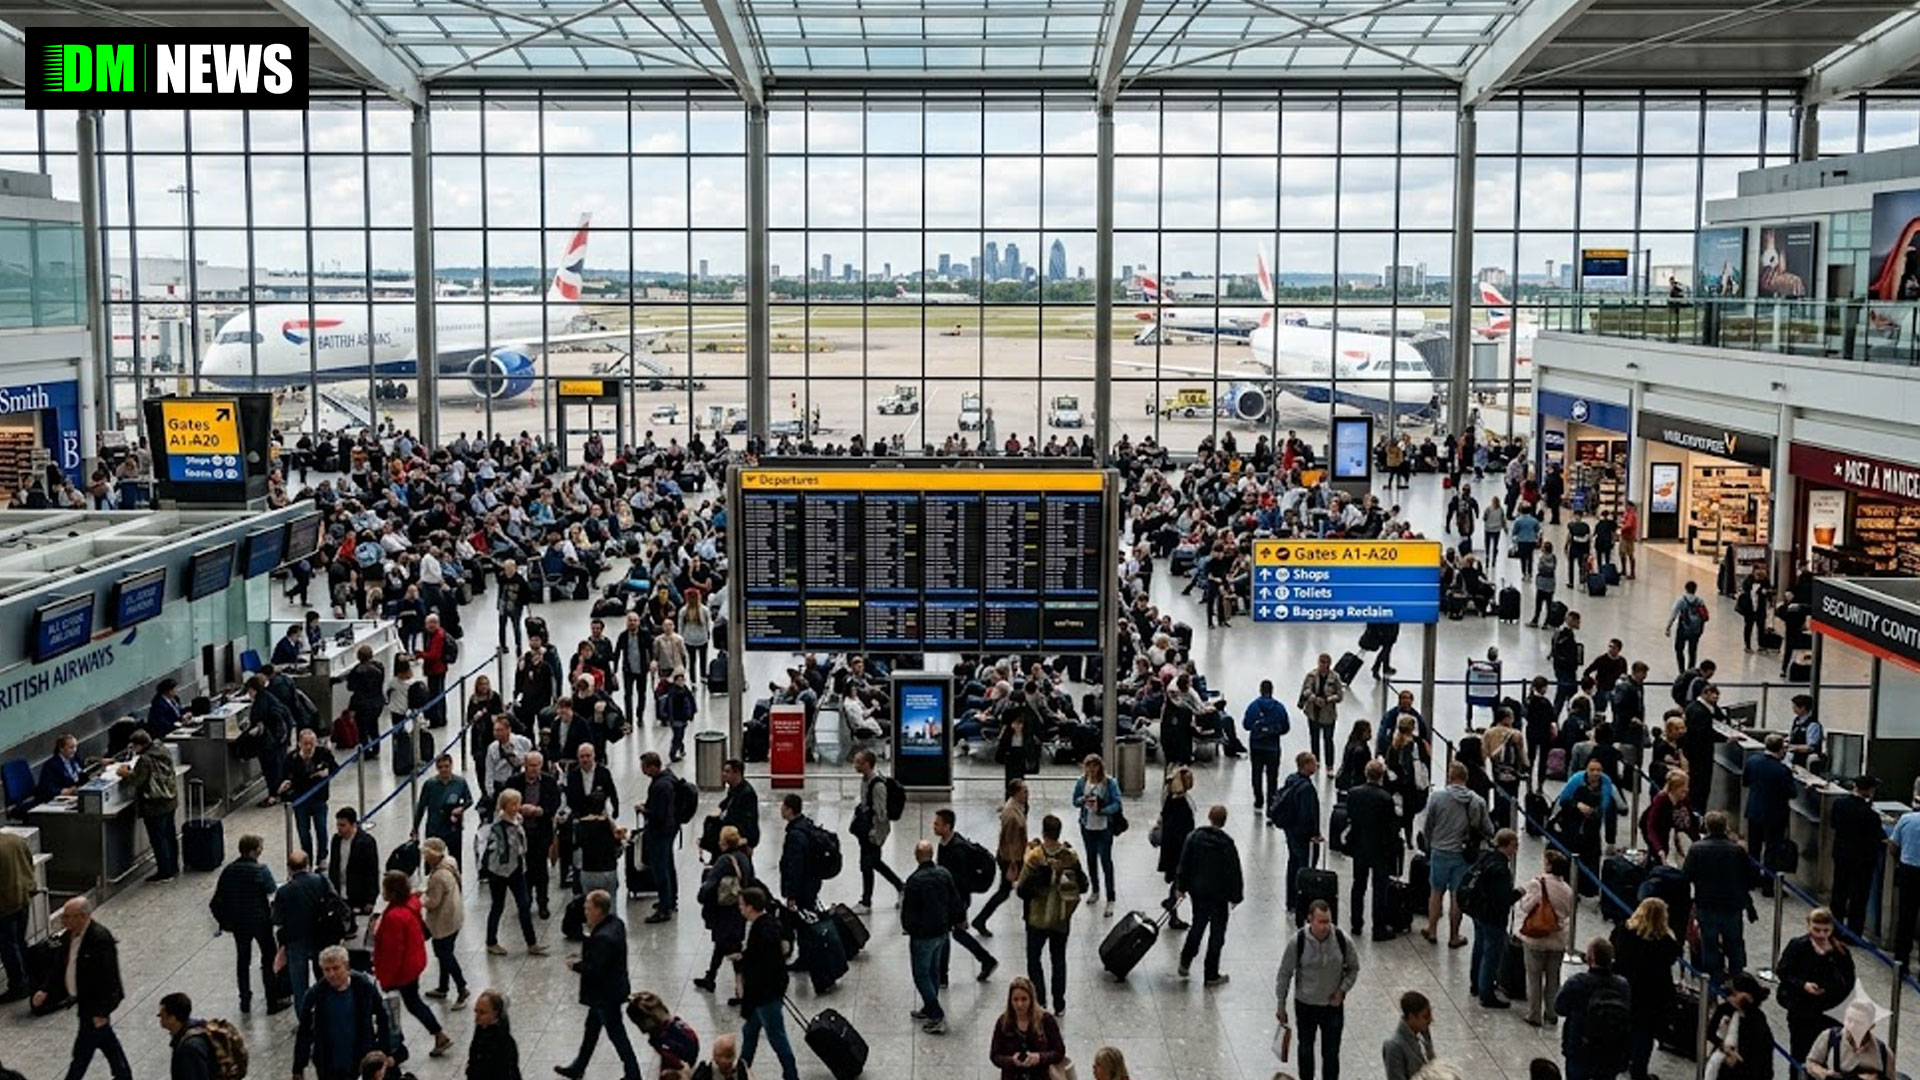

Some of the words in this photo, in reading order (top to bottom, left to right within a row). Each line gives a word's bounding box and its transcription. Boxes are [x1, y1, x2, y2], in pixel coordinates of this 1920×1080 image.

[0, 384, 50, 414] Smith
[168, 418, 211, 431] Gates
[1294, 547, 1338, 561] Gates
[1342, 547, 1398, 561] A1-A20
[1292, 568, 1330, 582] Shops
[1822, 595, 1880, 632] SECURITY
[1881, 617, 1920, 650] CONT
[53, 644, 115, 689] AIRWAYS
